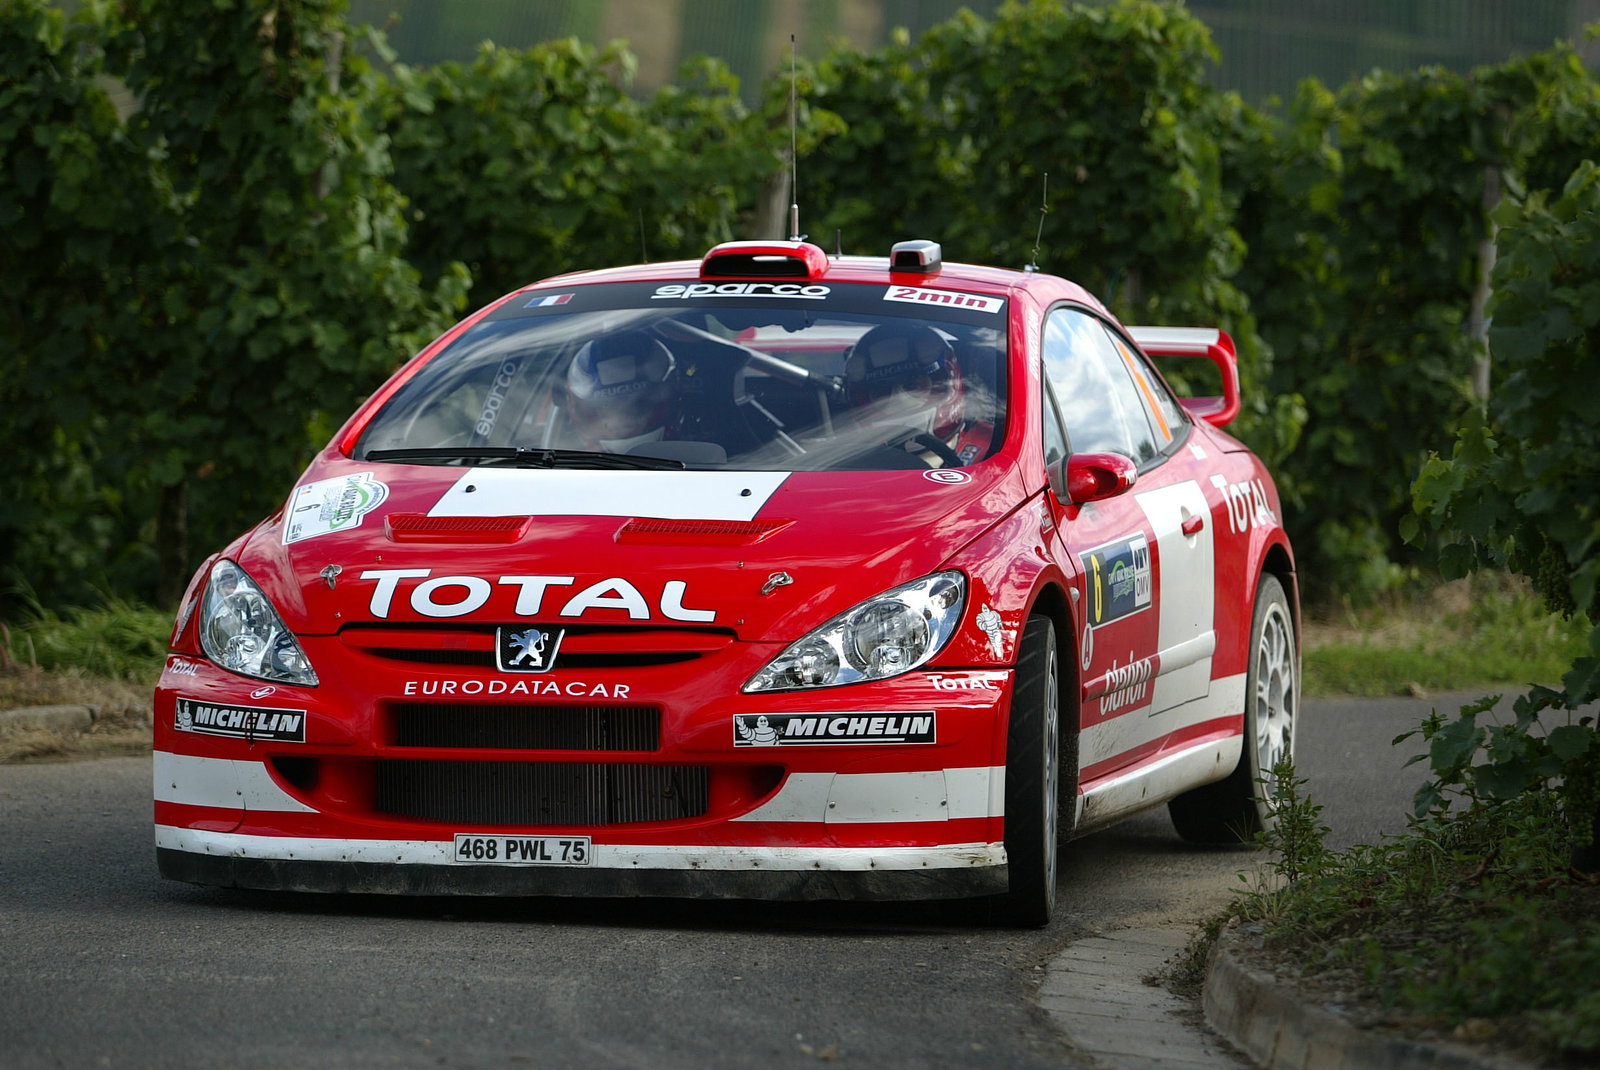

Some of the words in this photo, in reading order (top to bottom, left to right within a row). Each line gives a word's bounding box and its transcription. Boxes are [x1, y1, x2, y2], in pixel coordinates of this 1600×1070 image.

[651, 283, 831, 300] sparco
[892, 287, 988, 309] 2min
[476, 362, 516, 437] sparco
[295, 503, 321, 513] 6
[1210, 474, 1276, 534] TOTAL
[359, 568, 717, 623] TOTAL
[1090, 554, 1103, 623] 6
[169, 658, 199, 677] TOTAL
[404, 680, 631, 699] EURODATACAR
[926, 674, 998, 691] TOTAL
[1100, 650, 1152, 716] clarion
[194, 706, 302, 733] MICHELIN
[785, 715, 932, 736] MICHELIN
[459, 838, 498, 860] 468
[505, 839, 552, 861] PWL
[559, 840, 585, 862] 75
